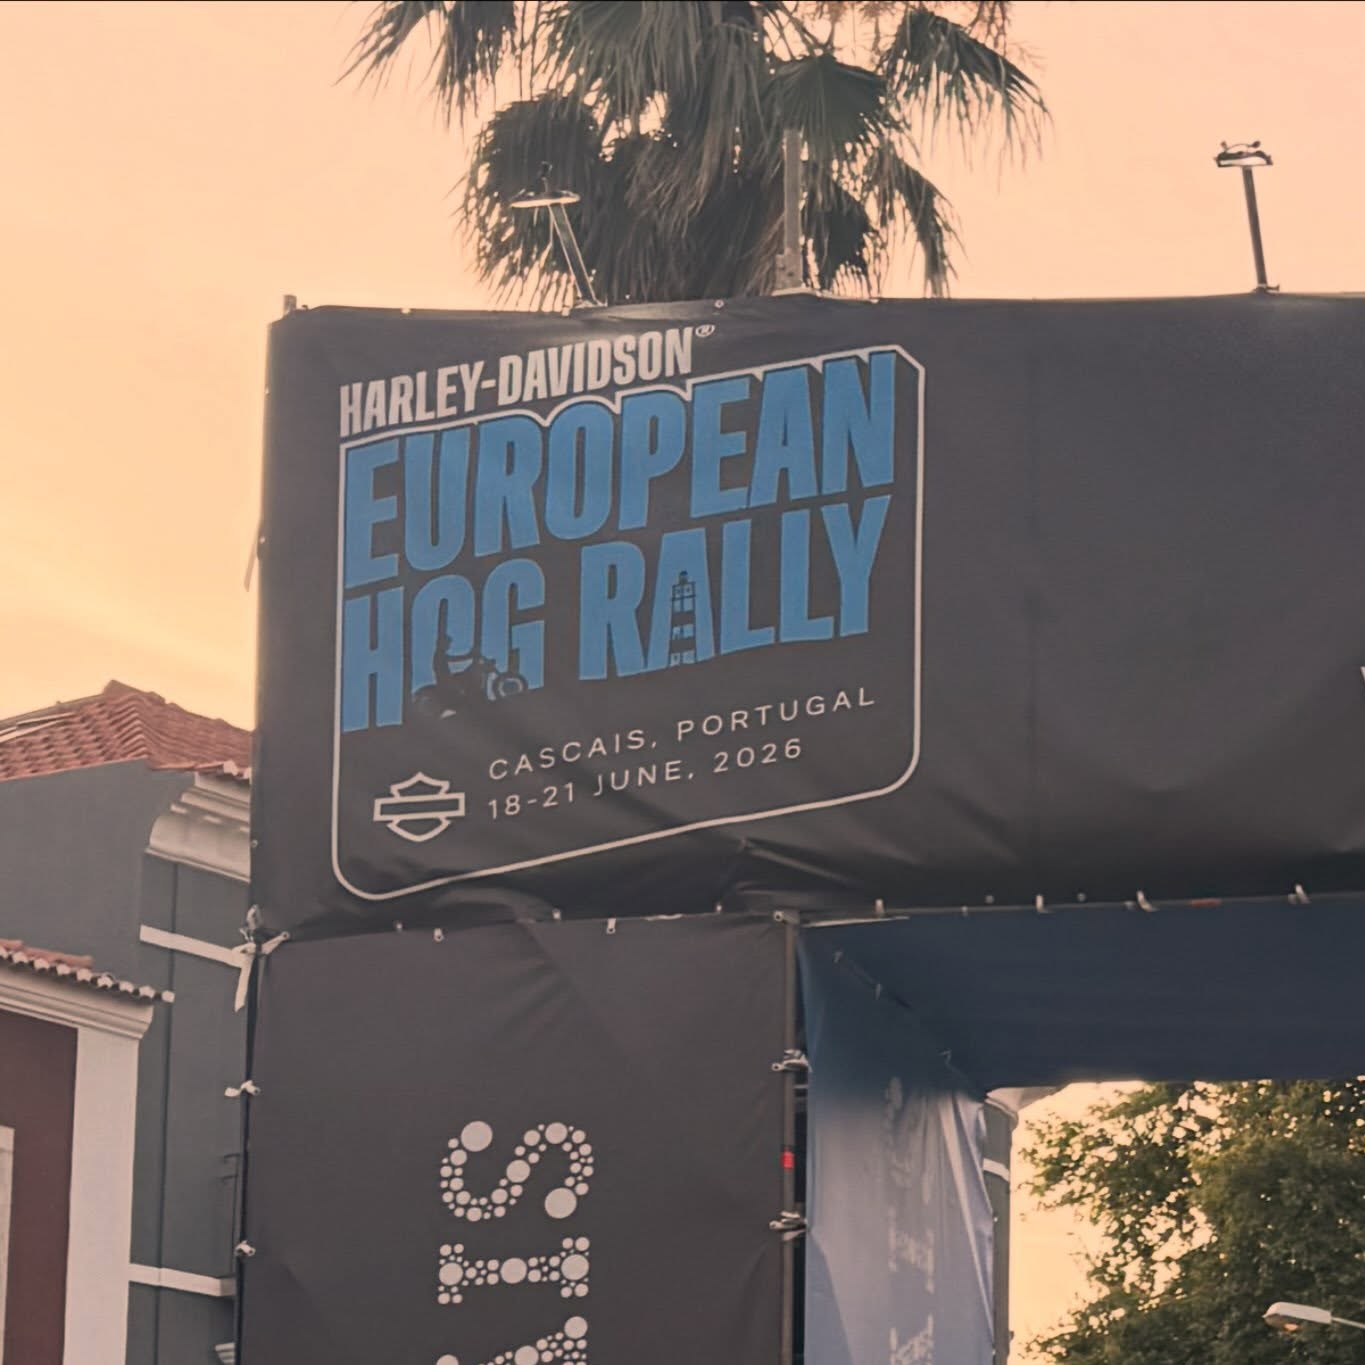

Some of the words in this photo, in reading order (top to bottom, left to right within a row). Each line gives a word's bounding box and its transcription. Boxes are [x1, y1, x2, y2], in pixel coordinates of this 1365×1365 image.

[344, 351, 896, 589] EUROPEAN
[341, 559, 545, 732] HOG
[577, 495, 891, 681] RALLY
[488, 783, 574, 820] 18-21
[592, 759, 694, 797] JUNE,
[713, 738, 801, 773] 2026
[489, 729, 657, 782] CASCAIS,
[677, 687, 875, 741] PORTUGAL
